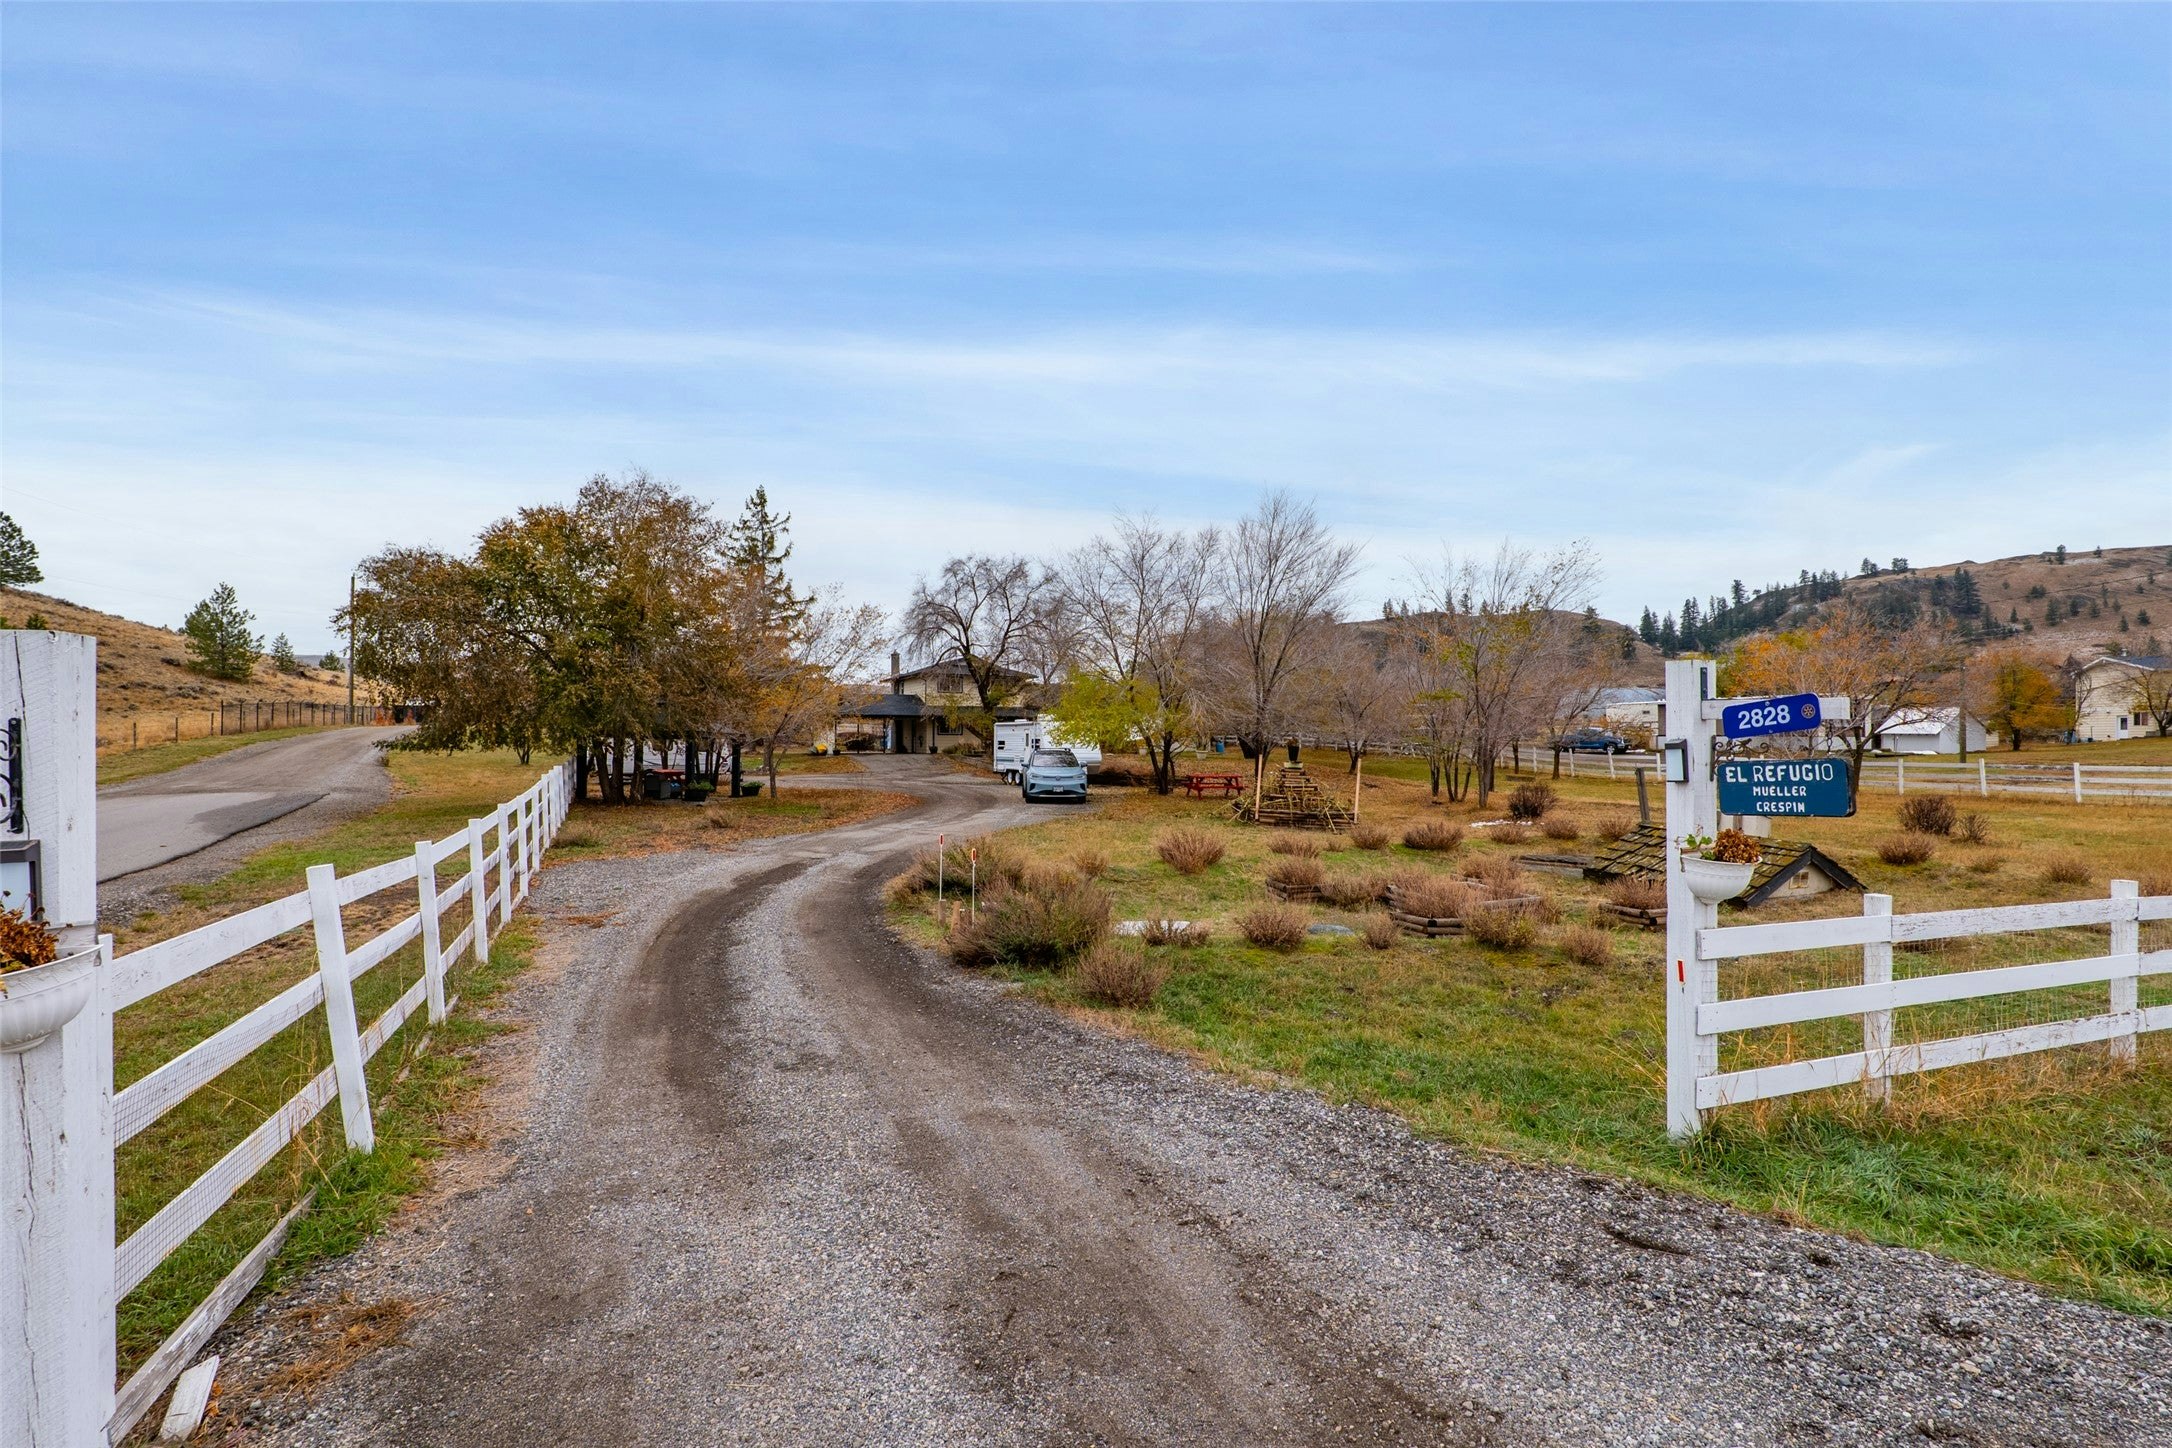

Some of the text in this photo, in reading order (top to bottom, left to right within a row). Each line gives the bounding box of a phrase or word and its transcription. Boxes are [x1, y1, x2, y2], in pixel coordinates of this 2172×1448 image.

[1738, 704, 1791, 730] 2828
[1725, 763, 1833, 783] EL REFUGIO
[1753, 785, 1807, 797] MUELLER
[1756, 801, 1805, 813] CRESPIN
